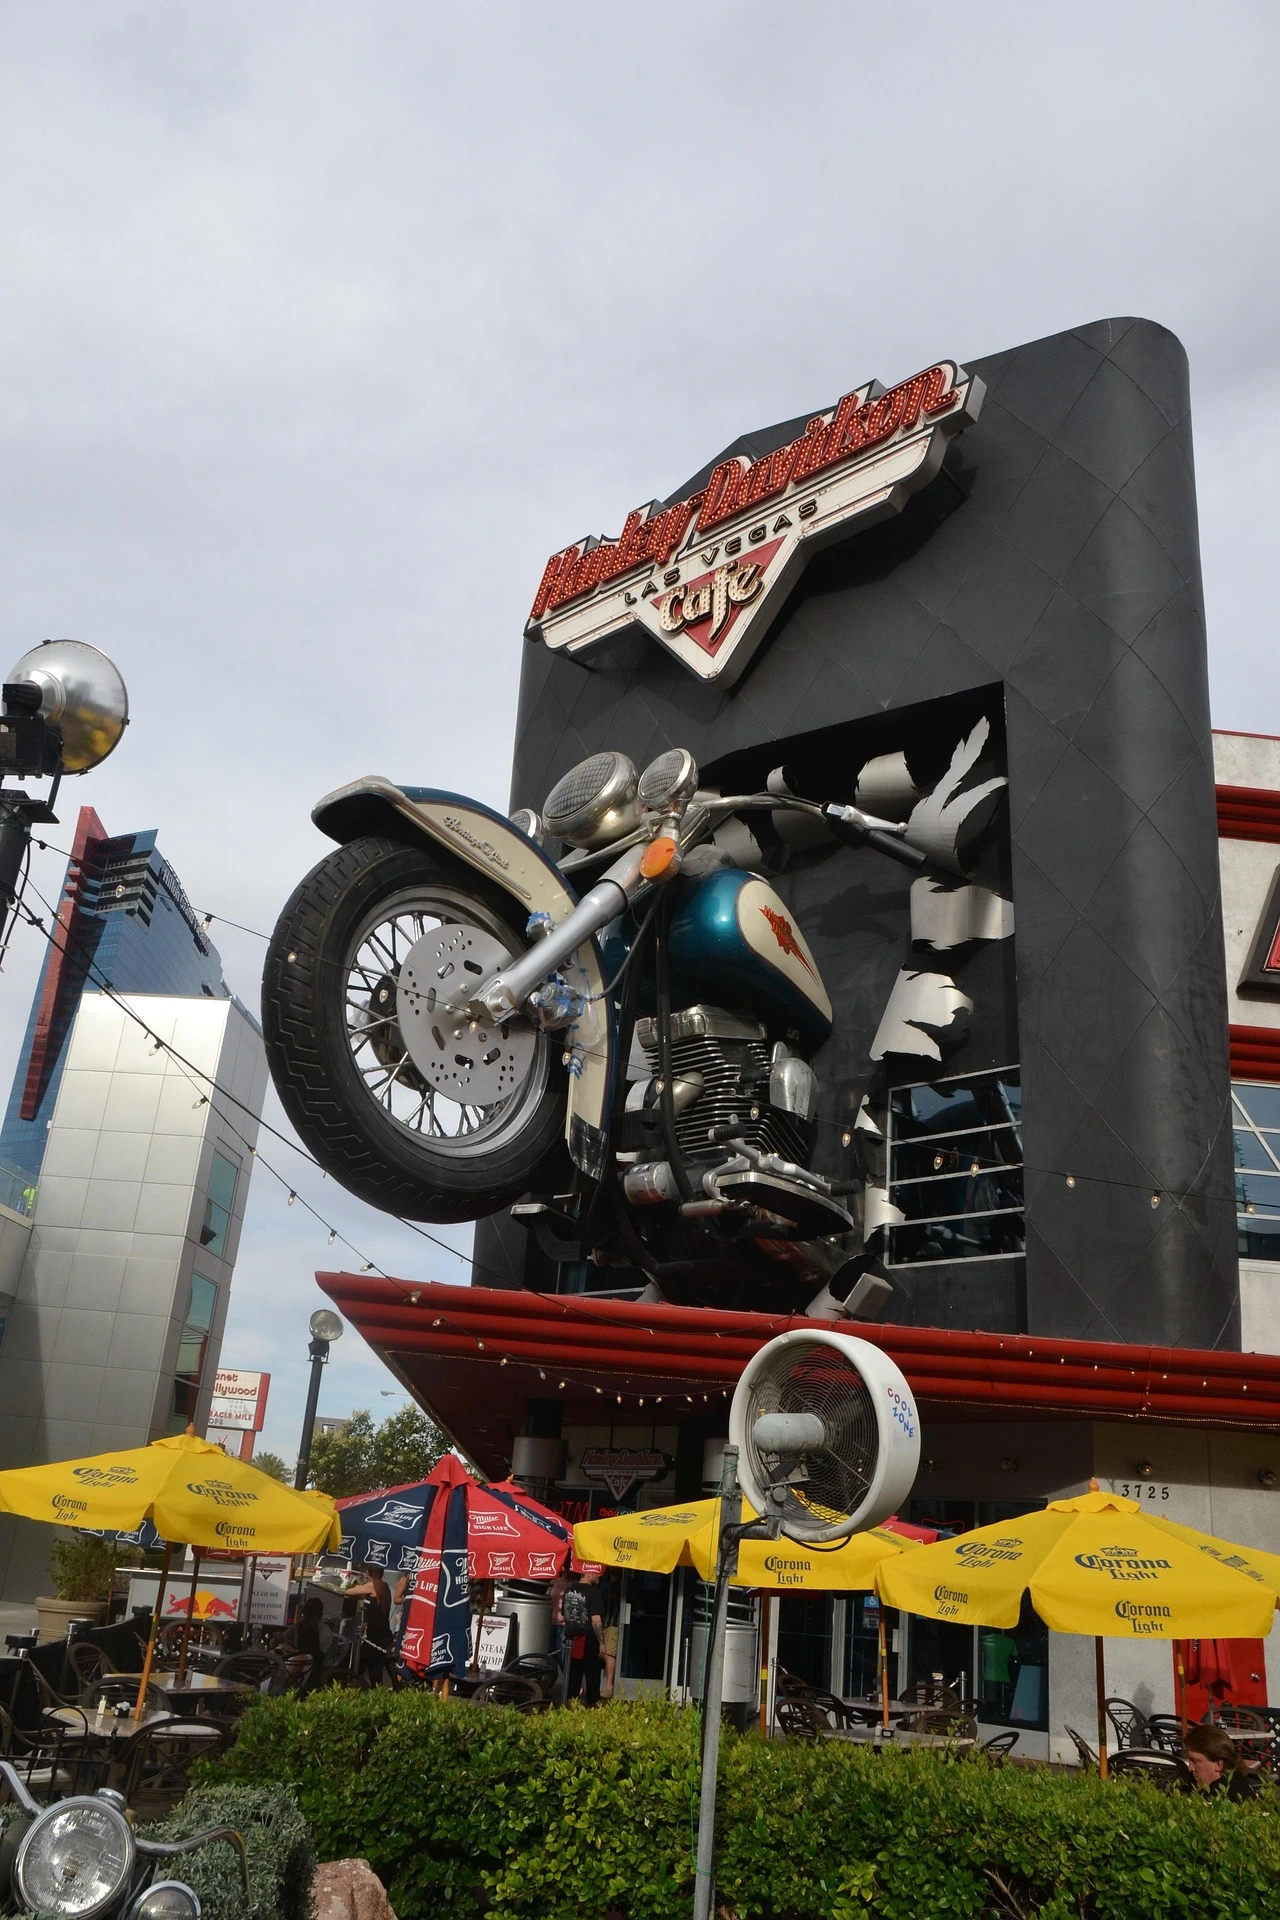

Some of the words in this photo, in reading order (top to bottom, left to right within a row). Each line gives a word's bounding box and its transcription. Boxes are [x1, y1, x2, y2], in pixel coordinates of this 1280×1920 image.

[624, 567, 680, 606] LAS
[701, 499, 818, 566] VEGAS
[216, 1373, 238, 1382] anet
[215, 1383, 257, 1396] llywood
[887, 1387, 913, 1418] COOL
[209, 1411, 233, 1419] RACLE
[892, 1406, 914, 1438] ZONE
[72, 1467, 139, 1484] Corona
[186, 1483, 260, 1501] Corona
[1121, 1484, 1170, 1500] 3725
[52, 1493, 88, 1511] Corona
[215, 1521, 256, 1537] Corona
[225, 1536, 248, 1548] Light
[613, 1536, 639, 1551] Corona
[955, 1542, 1023, 1561] Corona
[764, 1555, 812, 1572] Corona
[1074, 1553, 1172, 1571] Corona
[777, 1571, 804, 1585] Light
[1106, 1568, 1159, 1581] Light
[420, 1580, 439, 1593] LIFE
[934, 1585, 968, 1604] Corona
[937, 1601, 959, 1616] Light
[1115, 1600, 1171, 1620] Corona
[1132, 1617, 1164, 1634] Light
[480, 1643, 506, 1654] STEAK
[478, 1655, 503, 1666] HRIMP
